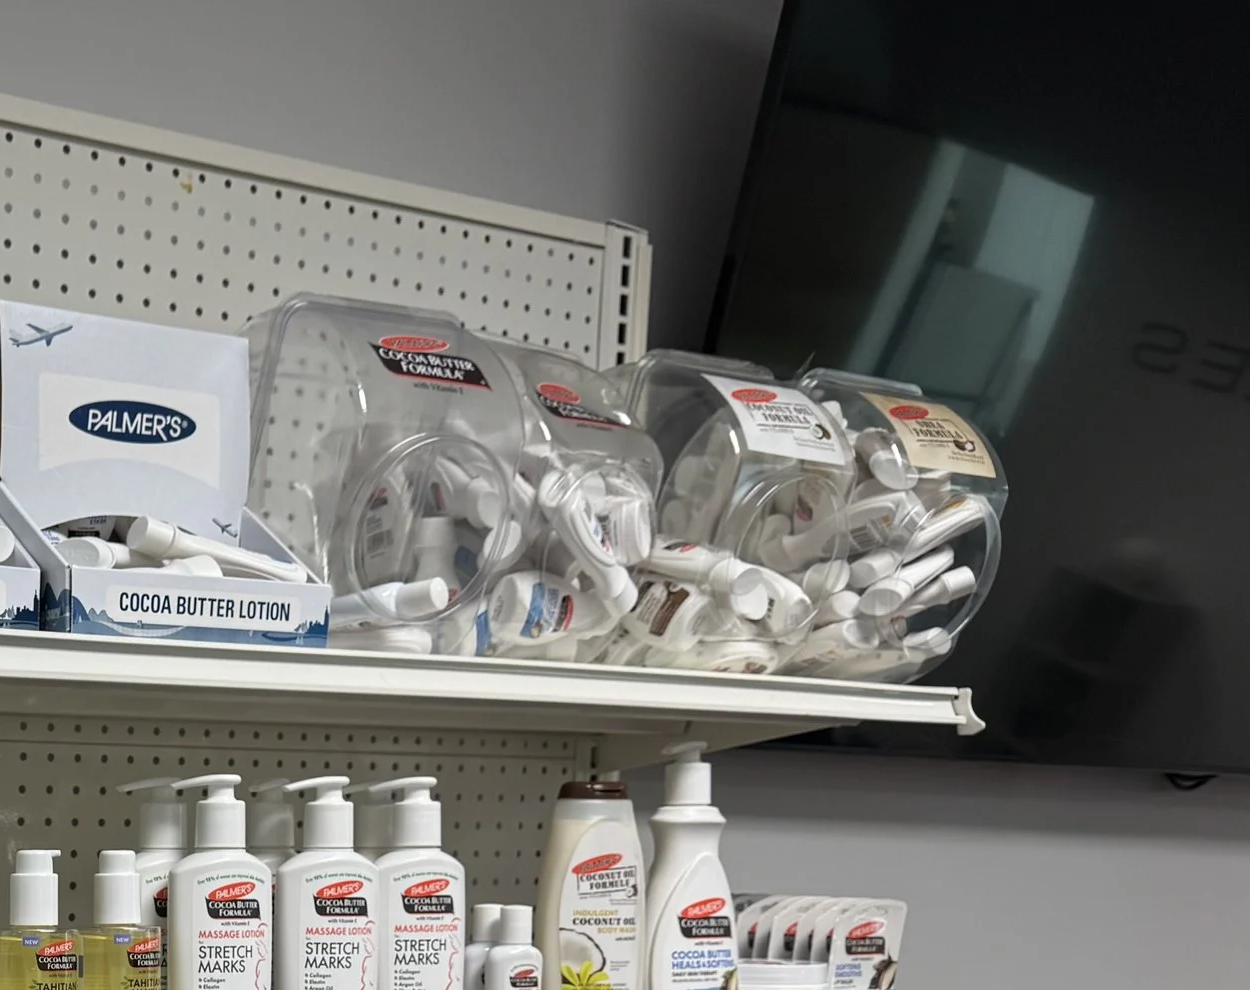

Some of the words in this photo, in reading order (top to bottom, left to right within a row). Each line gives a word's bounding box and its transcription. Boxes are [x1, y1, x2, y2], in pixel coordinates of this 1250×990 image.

[379, 349, 425, 365] COCOA
[426, 356, 474, 371] BUTTER
[400, 362, 460, 380] FORMULA
[87, 408, 182, 442] PALMER'S
[913, 428, 963, 440] FORMULA
[119, 591, 171, 615] COCOA
[176, 595, 235, 619] BUTTER
[239, 598, 290, 622] LOTION
[216, 884, 252, 899] PALMER'S
[209, 901, 235, 909] COCOA
[199, 930, 240, 938] MASSAGE
[242, 929, 264, 937] LOTION
[306, 927, 347, 935] MASSAGE
[348, 927, 372, 935] LOTION
[436, 924, 458, 932] LOTION
[306, 942, 359, 954] STRETCH
[395, 939, 446, 952] STRETCH
[199, 946, 253, 958] STRETCH
[672, 951, 705, 959] COCOA
[708, 950, 731, 958] BUTTER
[305, 956, 351, 969] MARKS
[394, 953, 439, 965] MARKS
[198, 960, 245, 973] MARKS
